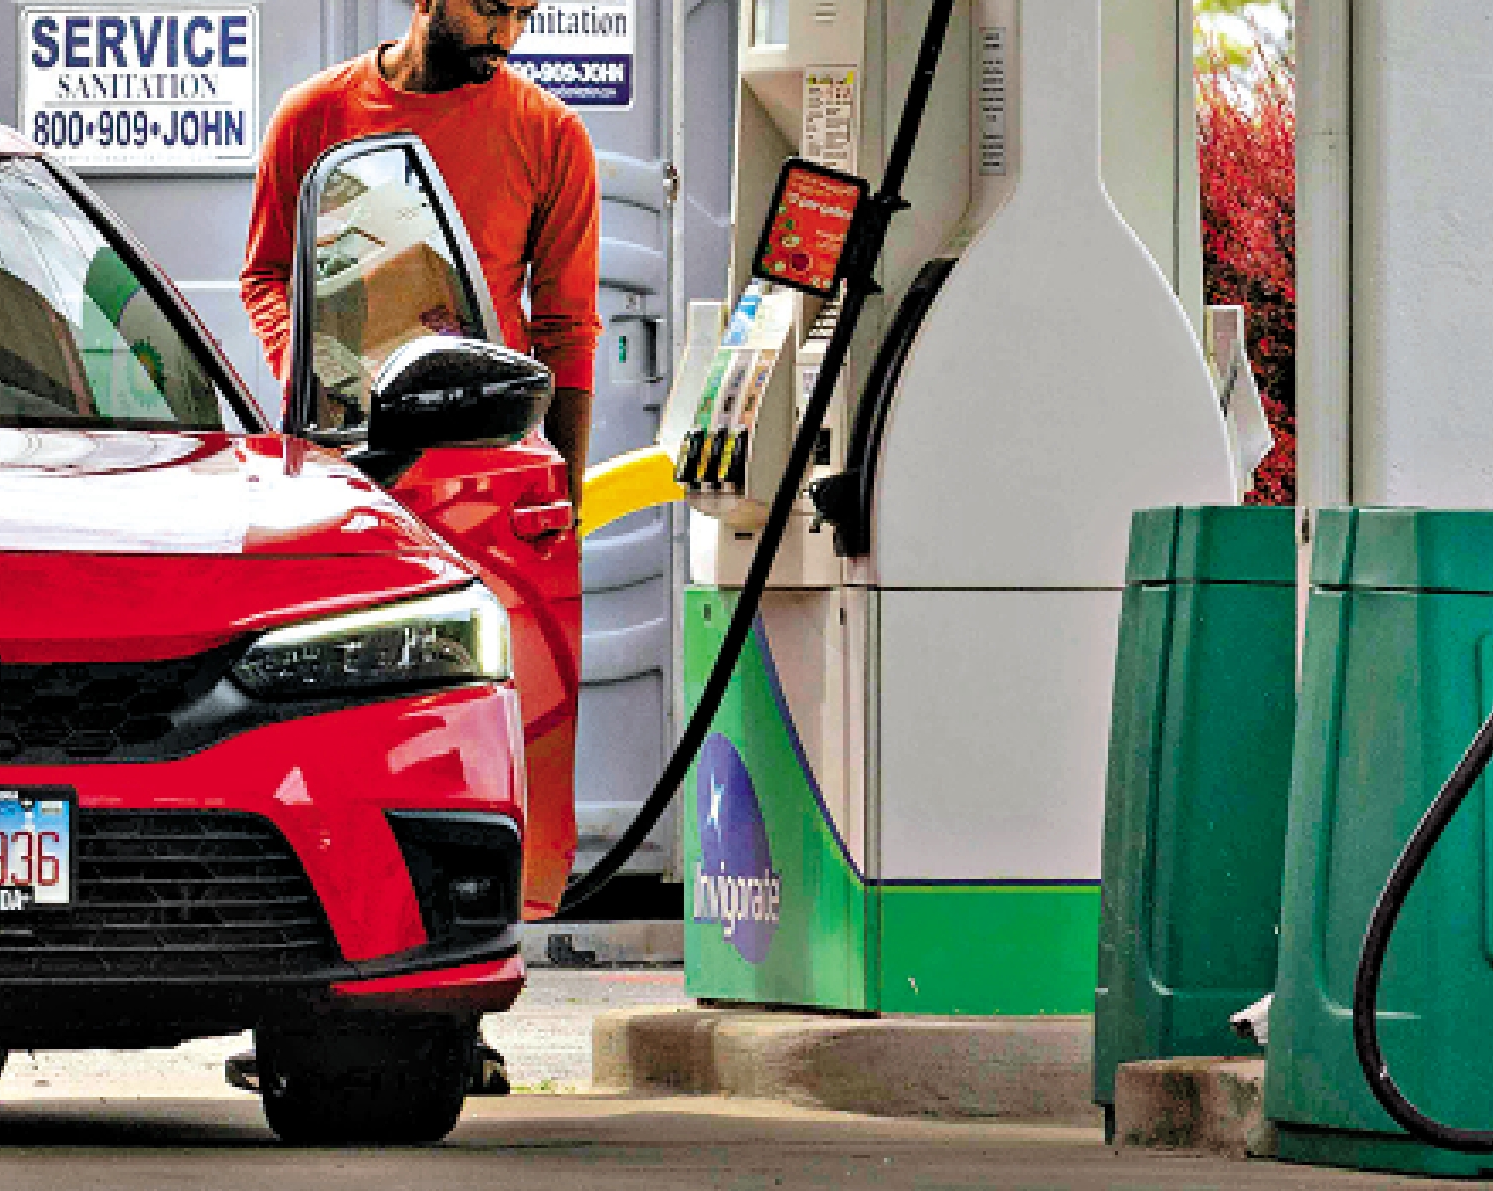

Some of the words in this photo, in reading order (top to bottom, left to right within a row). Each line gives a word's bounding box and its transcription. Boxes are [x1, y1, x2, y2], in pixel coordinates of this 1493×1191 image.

[31, 14, 249, 70] SERVICE
[524, 6, 627, 38] nitation
[56, 73, 219, 99] SANITATION
[693, 858, 781, 940] Invigorate
